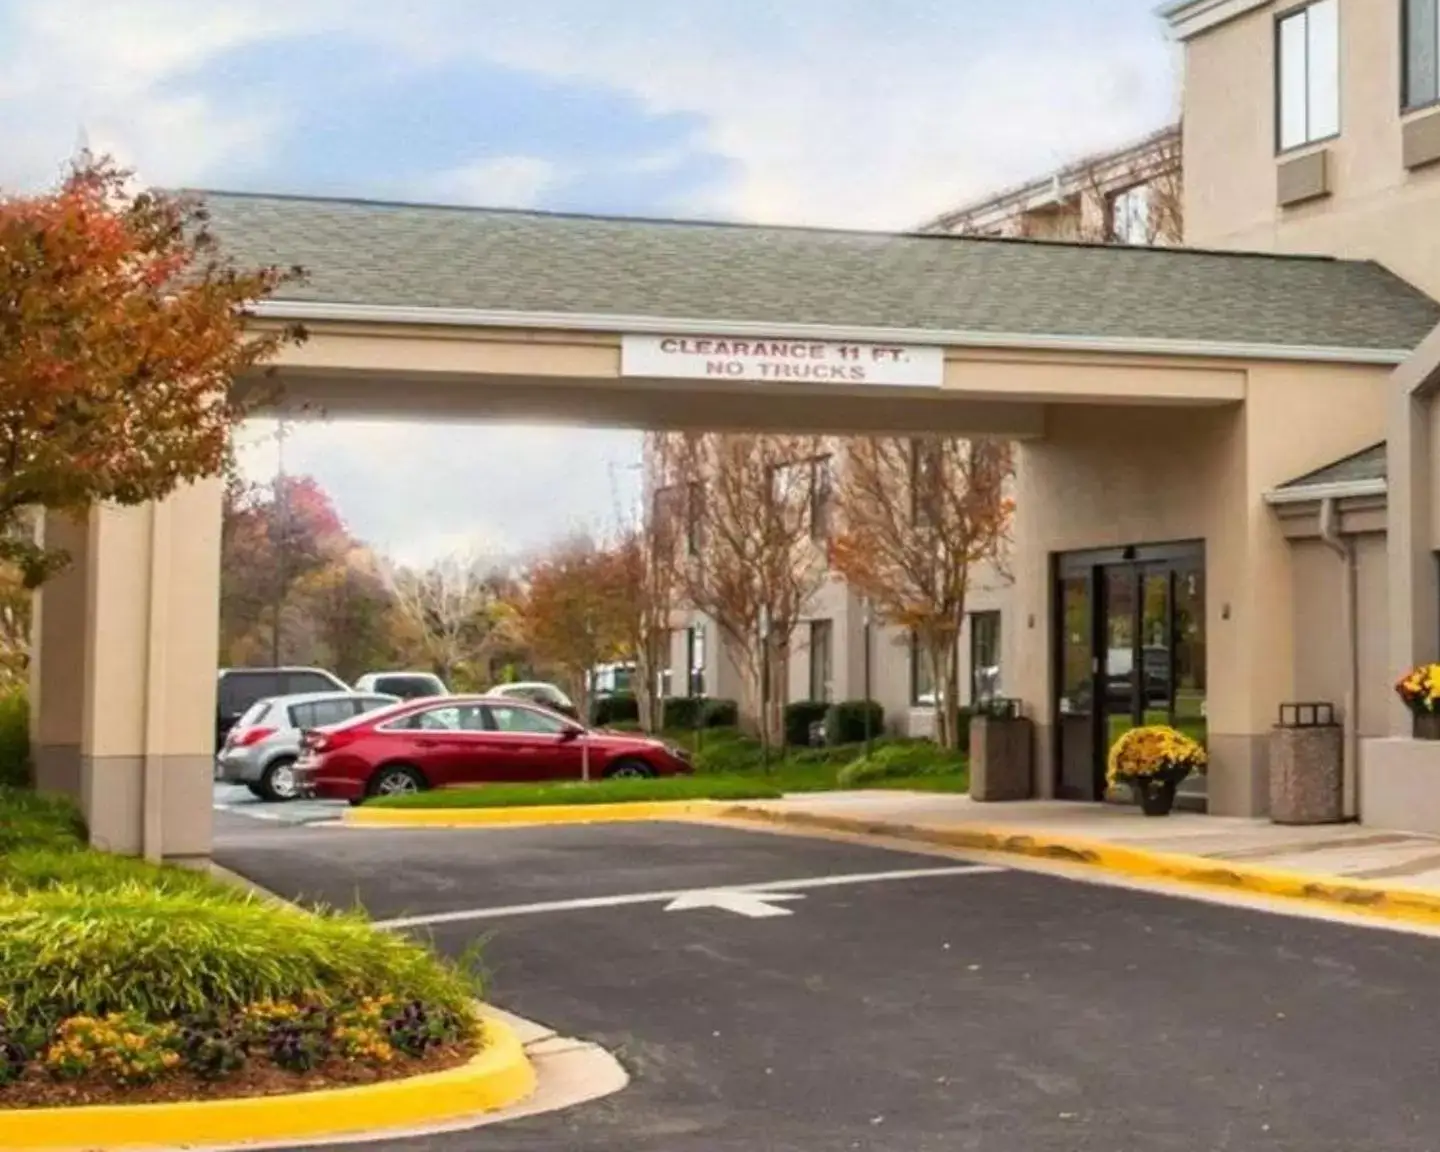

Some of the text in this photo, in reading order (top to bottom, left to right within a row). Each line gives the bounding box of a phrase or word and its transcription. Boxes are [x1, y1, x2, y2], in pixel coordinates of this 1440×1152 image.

[659, 338, 826, 361] CLEARANCE
[836, 346, 861, 362] 11
[705, 360, 868, 380] NO TRUCKS
